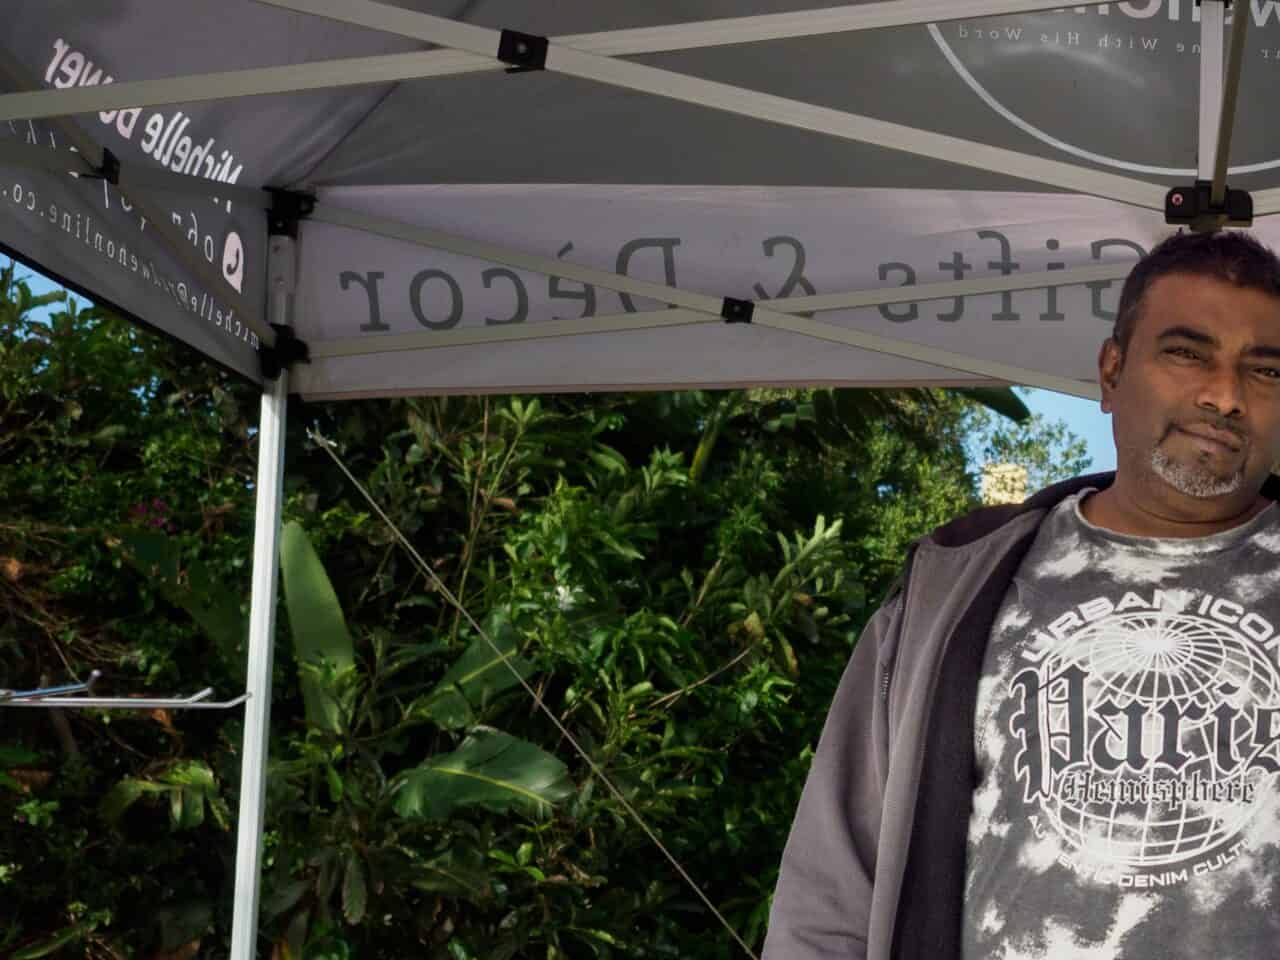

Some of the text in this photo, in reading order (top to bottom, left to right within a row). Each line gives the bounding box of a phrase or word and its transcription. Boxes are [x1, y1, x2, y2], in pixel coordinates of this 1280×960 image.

[1021, 589, 1194, 662] URBAN
[1063, 771, 1256, 811] Hemisphere
[1118, 868, 1189, 889] DENIM
